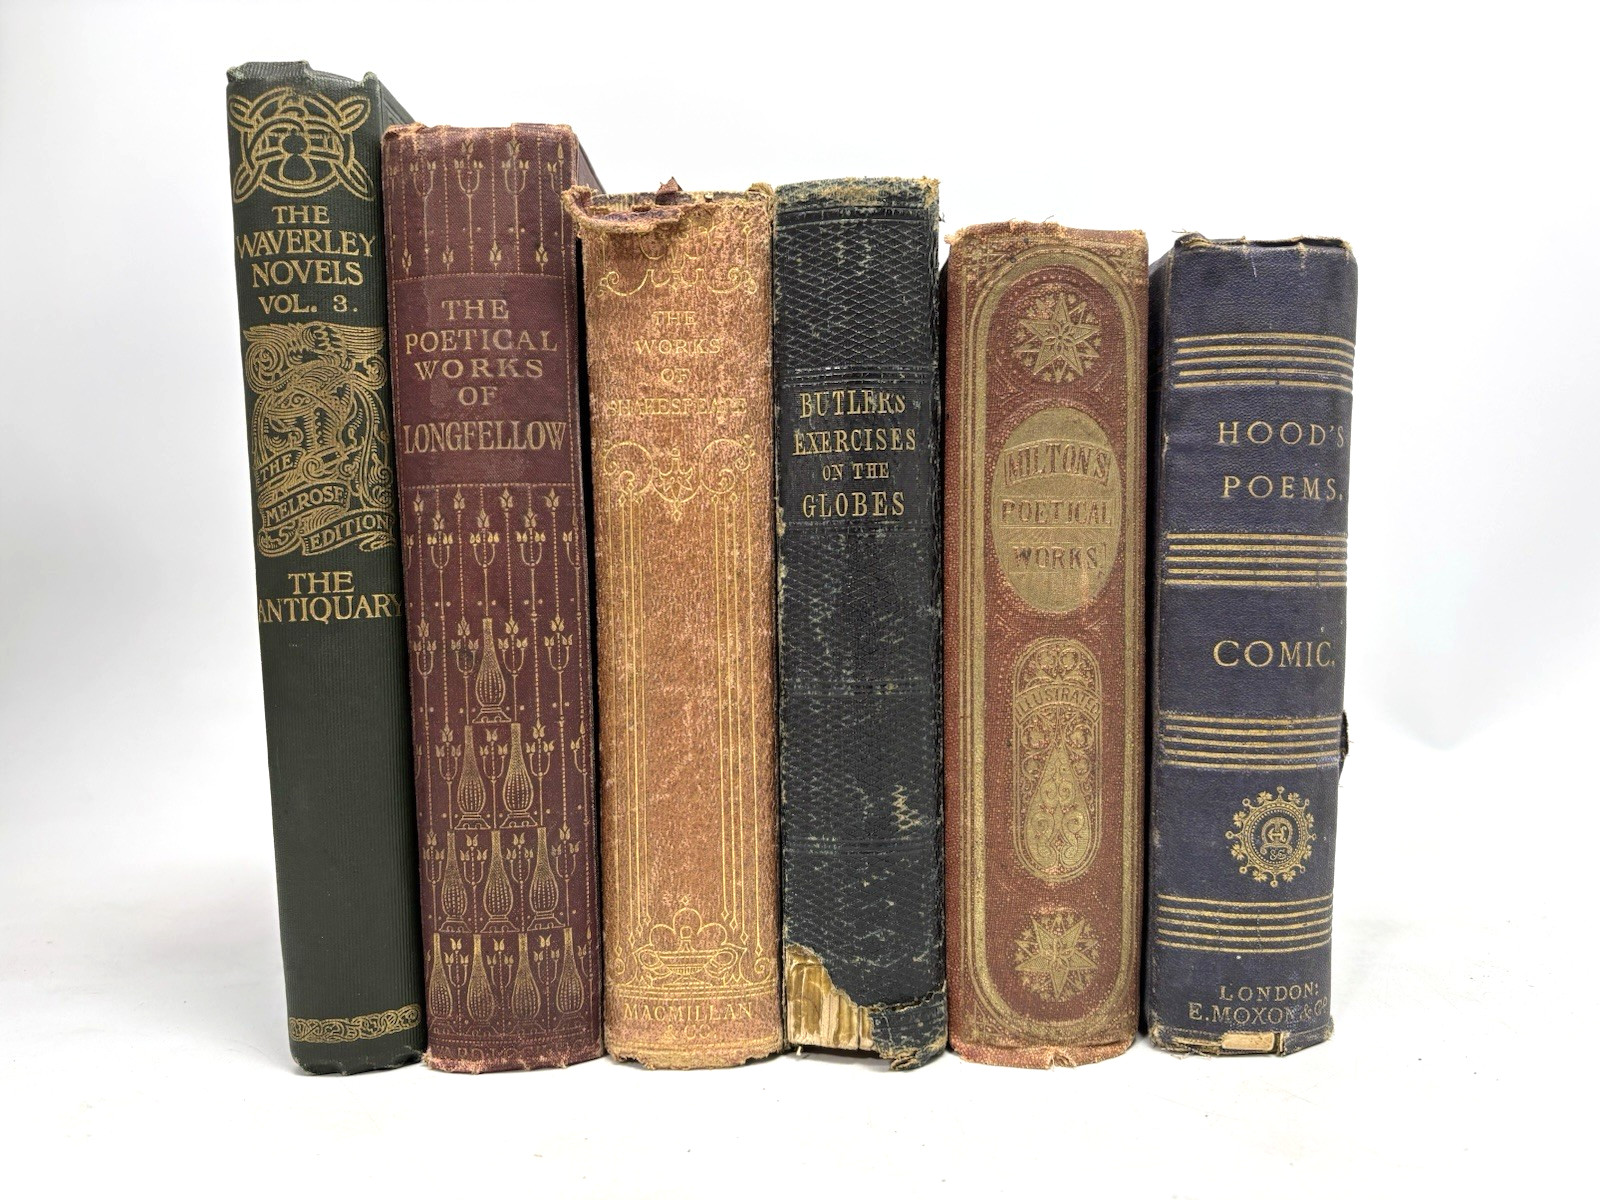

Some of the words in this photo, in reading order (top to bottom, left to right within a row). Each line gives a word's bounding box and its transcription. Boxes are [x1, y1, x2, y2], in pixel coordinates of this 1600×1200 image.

[271, 204, 330, 225] THE
[235, 228, 378, 260] WAVERLEY
[251, 258, 365, 289] NOVELS
[257, 294, 319, 315] VOL.
[441, 299, 509, 321] THE
[652, 310, 698, 327] THE
[404, 328, 558, 355] POETICAL
[633, 338, 722, 355] WORKS
[414, 357, 544, 381] WORKS
[660, 367, 691, 384] OF
[458, 385, 499, 406] OF
[402, 419, 567, 454] LONGFELLOW
[791, 427, 917, 456] EXERCISES
[1216, 421, 1345, 448] HOOD'S
[260, 453, 294, 482] THE
[822, 463, 845, 482] ON
[852, 461, 890, 480] THE
[265, 485, 345, 528] MELROSE
[802, 491, 906, 519] GLOBES
[1000, 498, 1113, 526] POETICAL
[309, 513, 391, 551] EDITION
[1012, 545, 1100, 571] WORKS
[287, 569, 356, 596] THE
[258, 592, 402, 625] ANTIQUARY
[1212, 639, 1336, 668] COMIC.
[1219, 981, 1320, 1002] LONDON:
[622, 1001, 753, 1022] MACMILLAN
